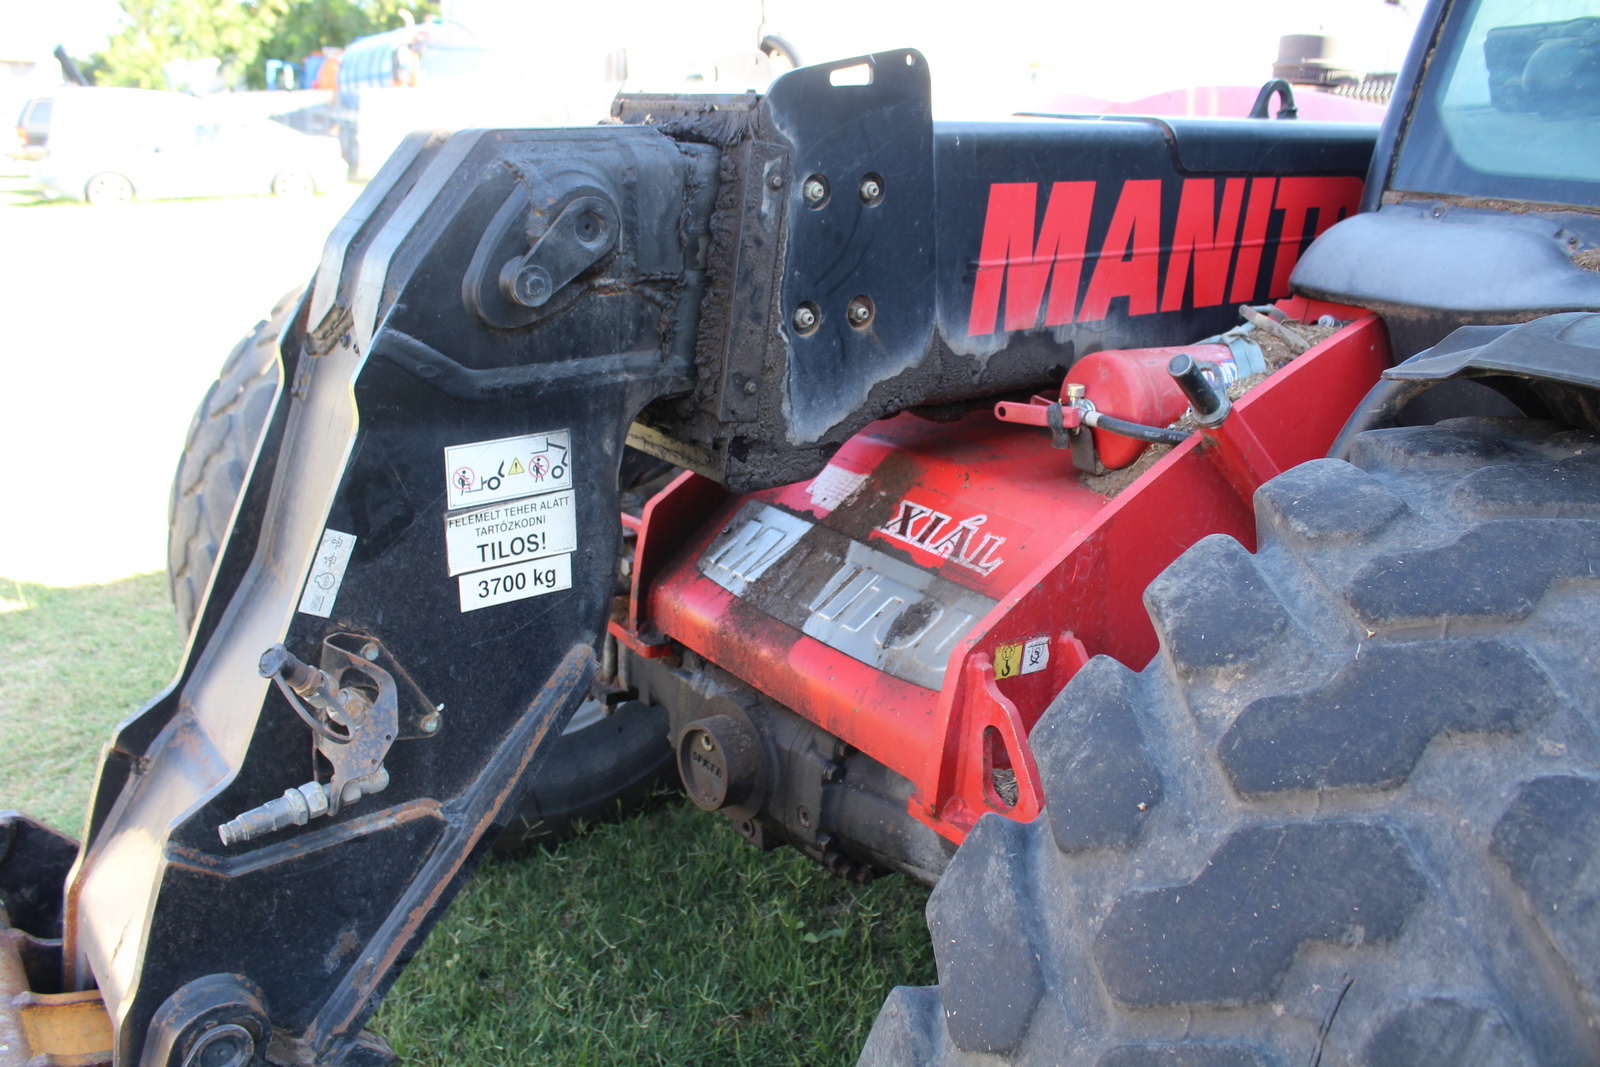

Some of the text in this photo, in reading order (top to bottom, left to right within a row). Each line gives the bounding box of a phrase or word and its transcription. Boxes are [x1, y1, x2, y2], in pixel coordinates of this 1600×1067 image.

[448, 496, 570, 528] FELEMELT TEHER ALATT
[475, 515, 546, 537] TARTÓZKODNI
[476, 531, 546, 563] TILOS!
[478, 568, 556, 598] 3700 kg
